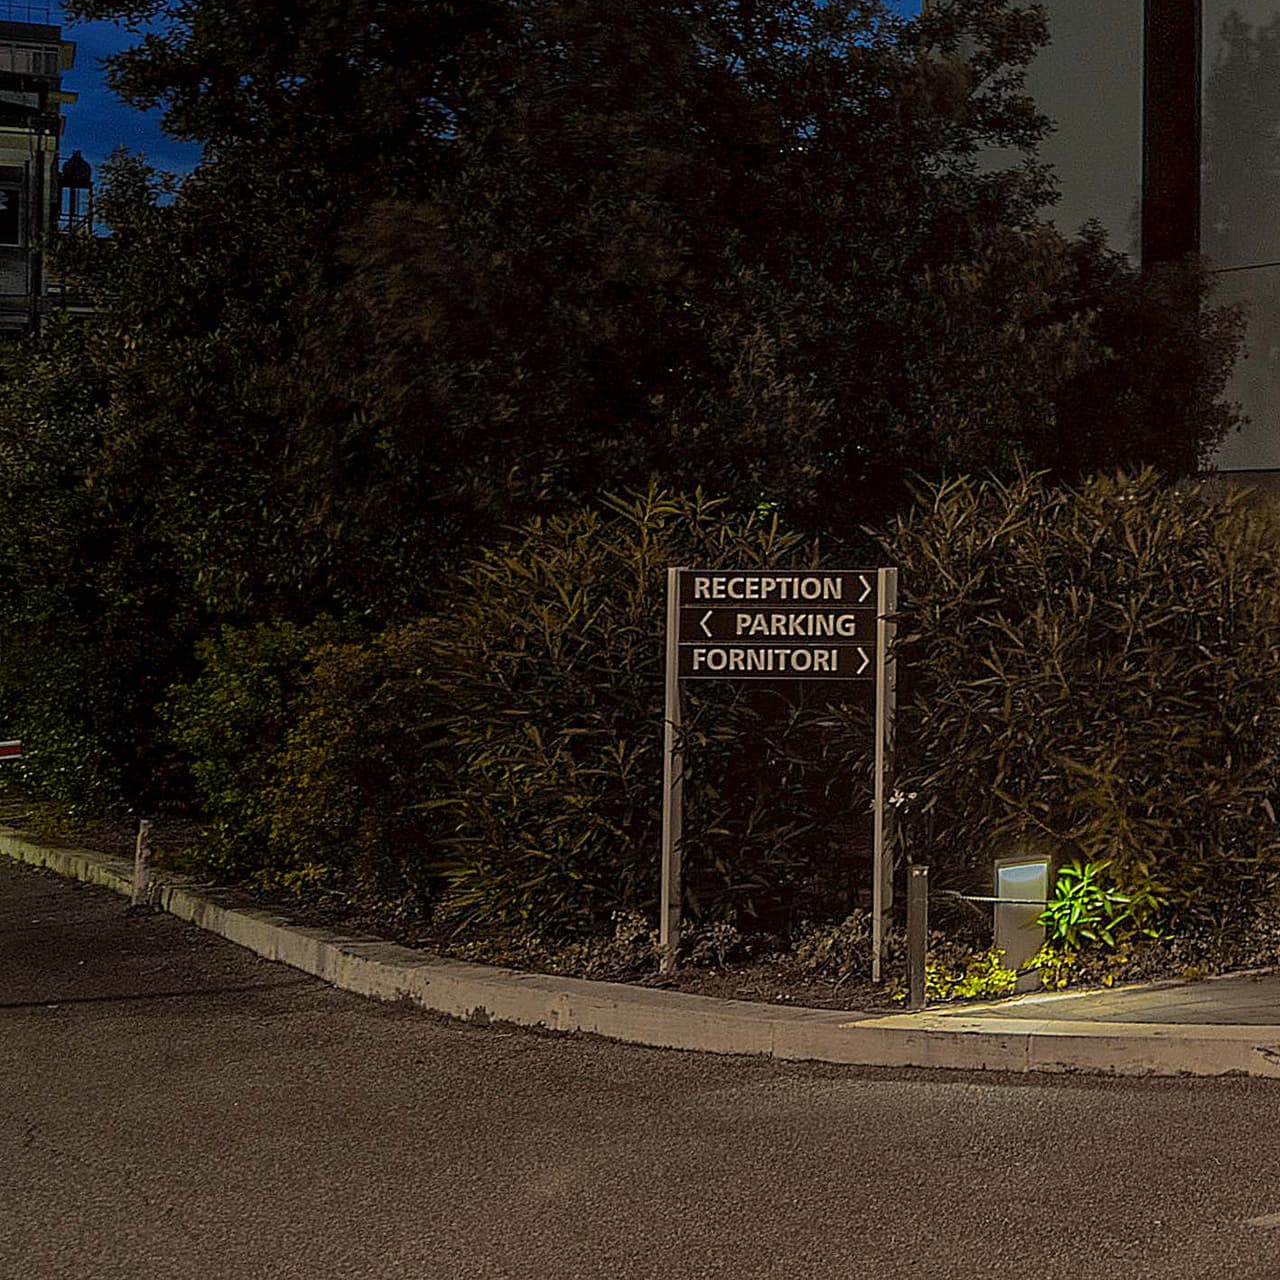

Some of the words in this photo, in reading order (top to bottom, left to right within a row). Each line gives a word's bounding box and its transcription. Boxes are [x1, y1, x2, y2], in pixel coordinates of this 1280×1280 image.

[694, 577, 843, 600] RECEPTION
[735, 613, 856, 637] PARKING
[692, 648, 838, 672] FORNITORI
